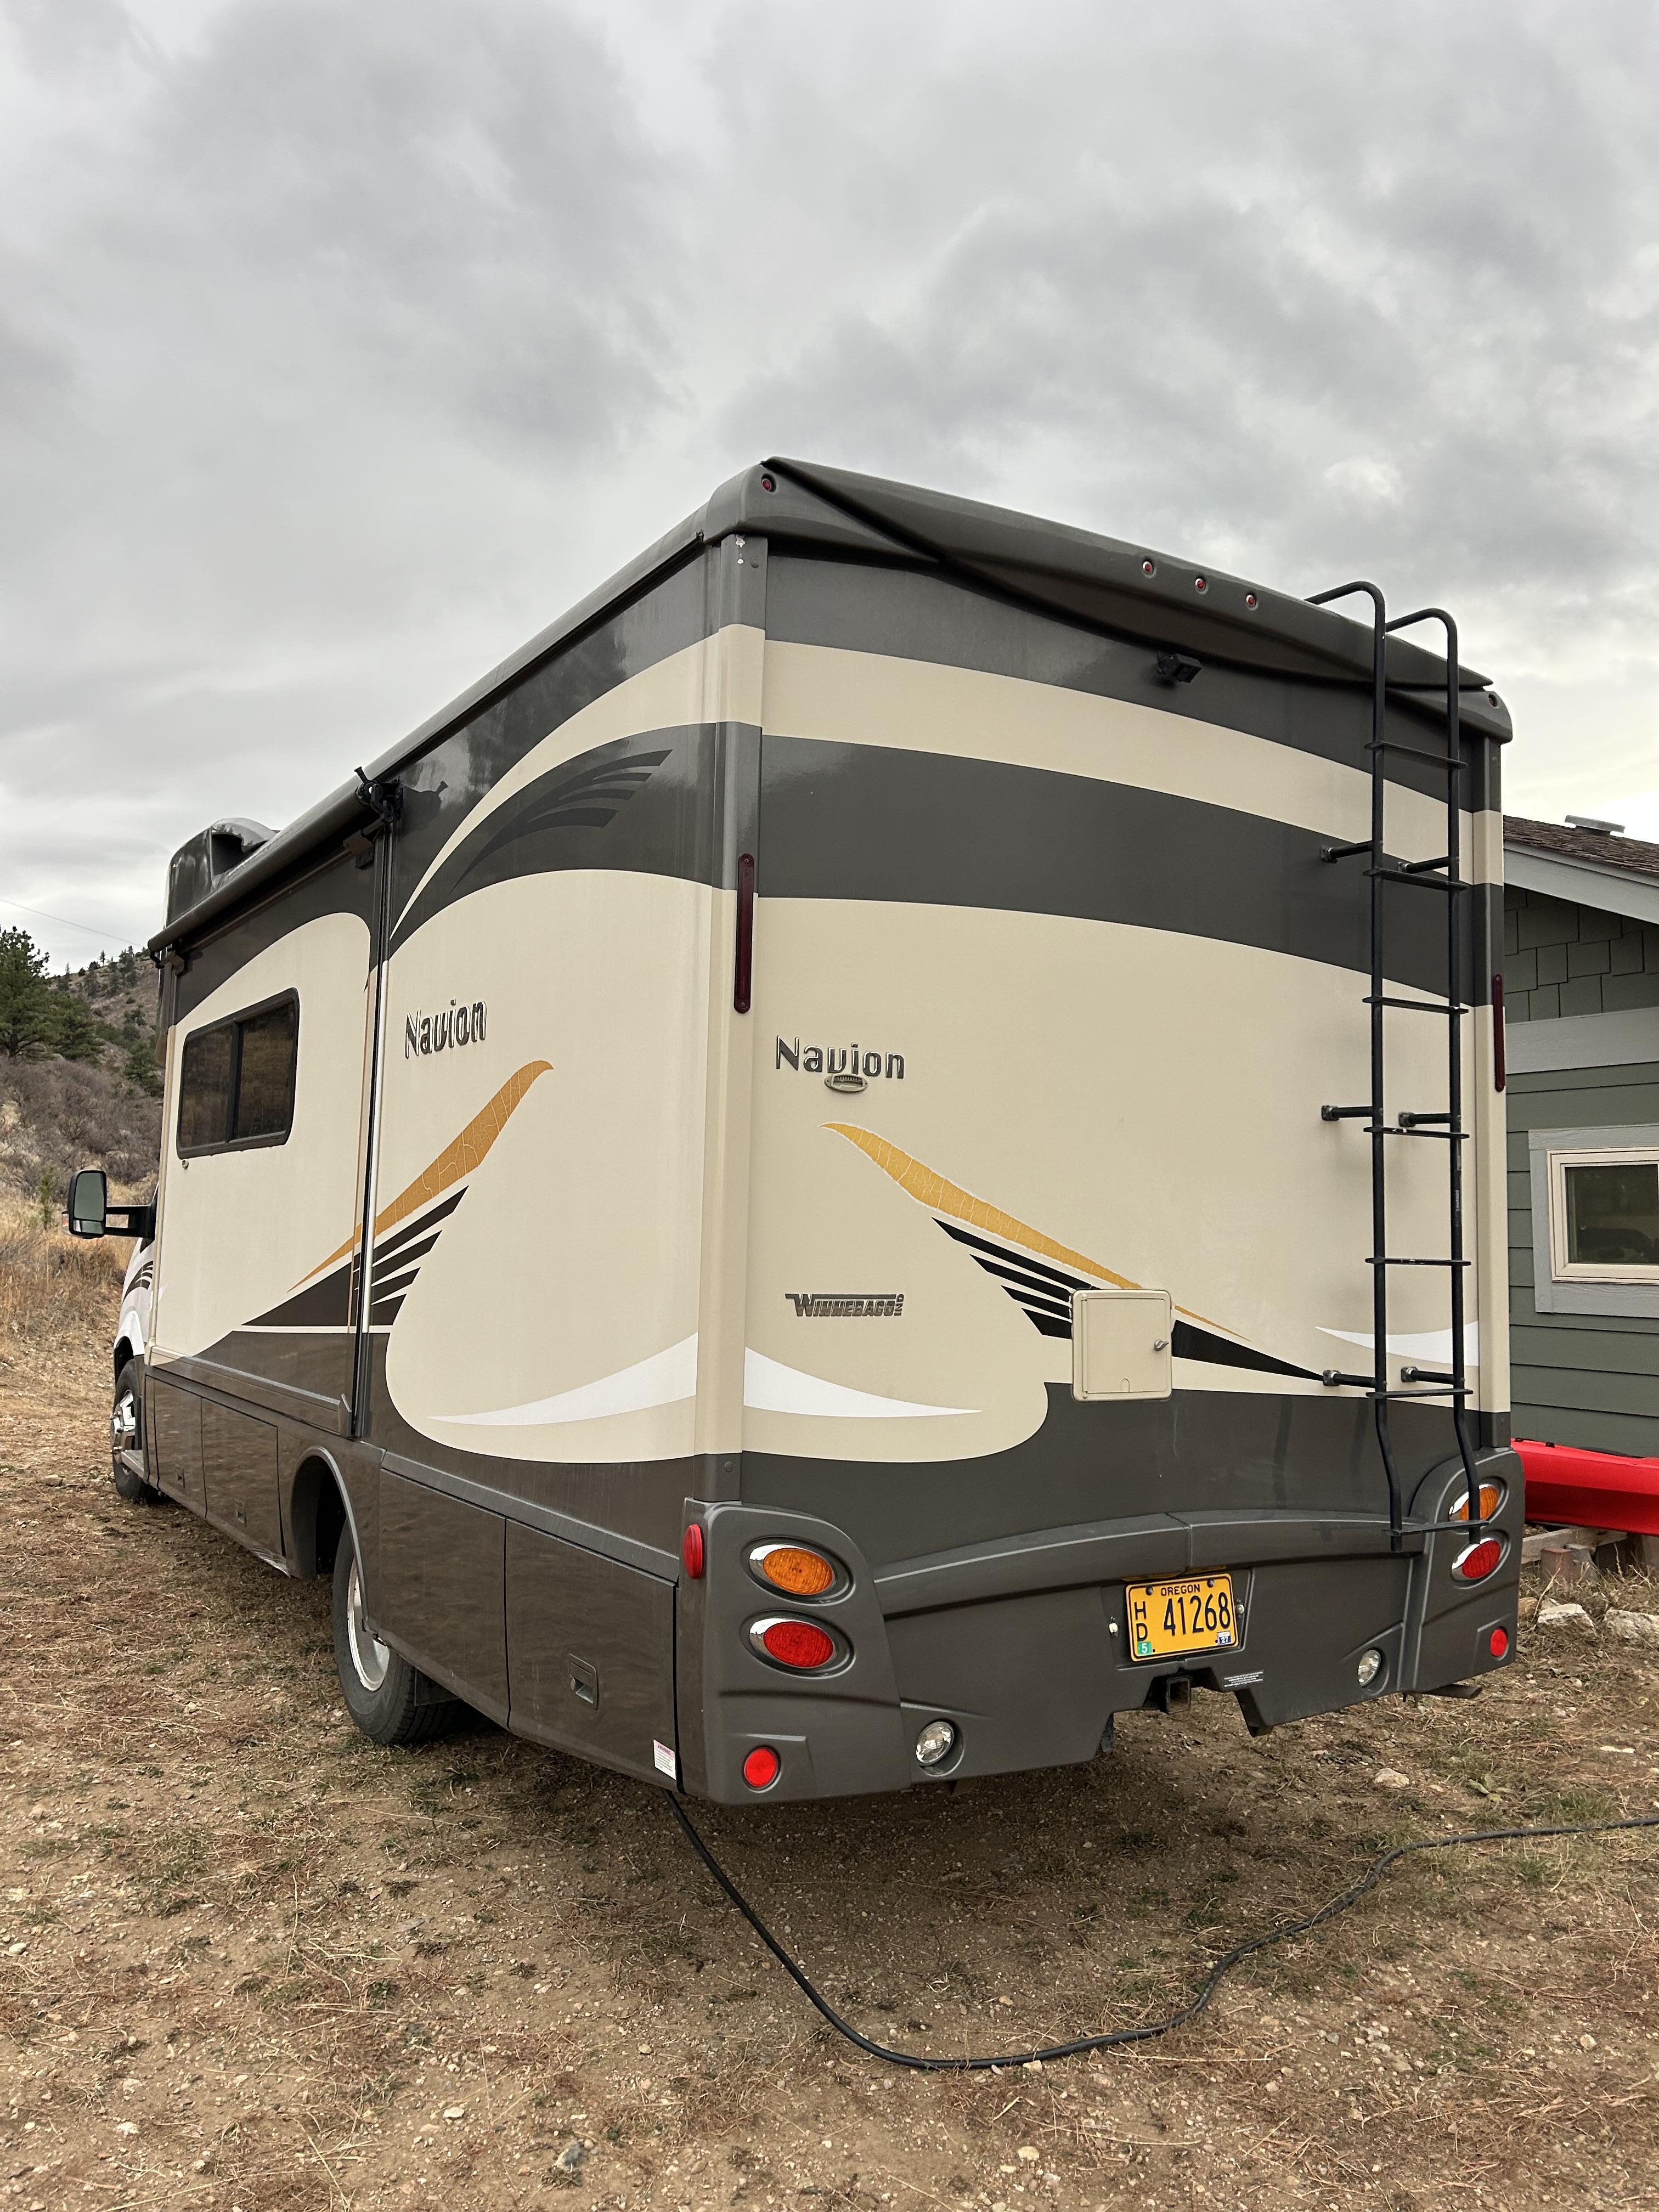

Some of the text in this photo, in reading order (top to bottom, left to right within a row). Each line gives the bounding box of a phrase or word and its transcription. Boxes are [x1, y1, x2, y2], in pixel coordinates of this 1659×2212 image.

[405, 997, 487, 1059] Navion
[775, 1035, 905, 1079] Navion
[785, 1293, 896, 1317] WINNEBAGO
[1161, 1584, 1200, 1596] OREGON
[1164, 1592, 1231, 1636] 41268
[1141, 1643, 1148, 1654] 5
